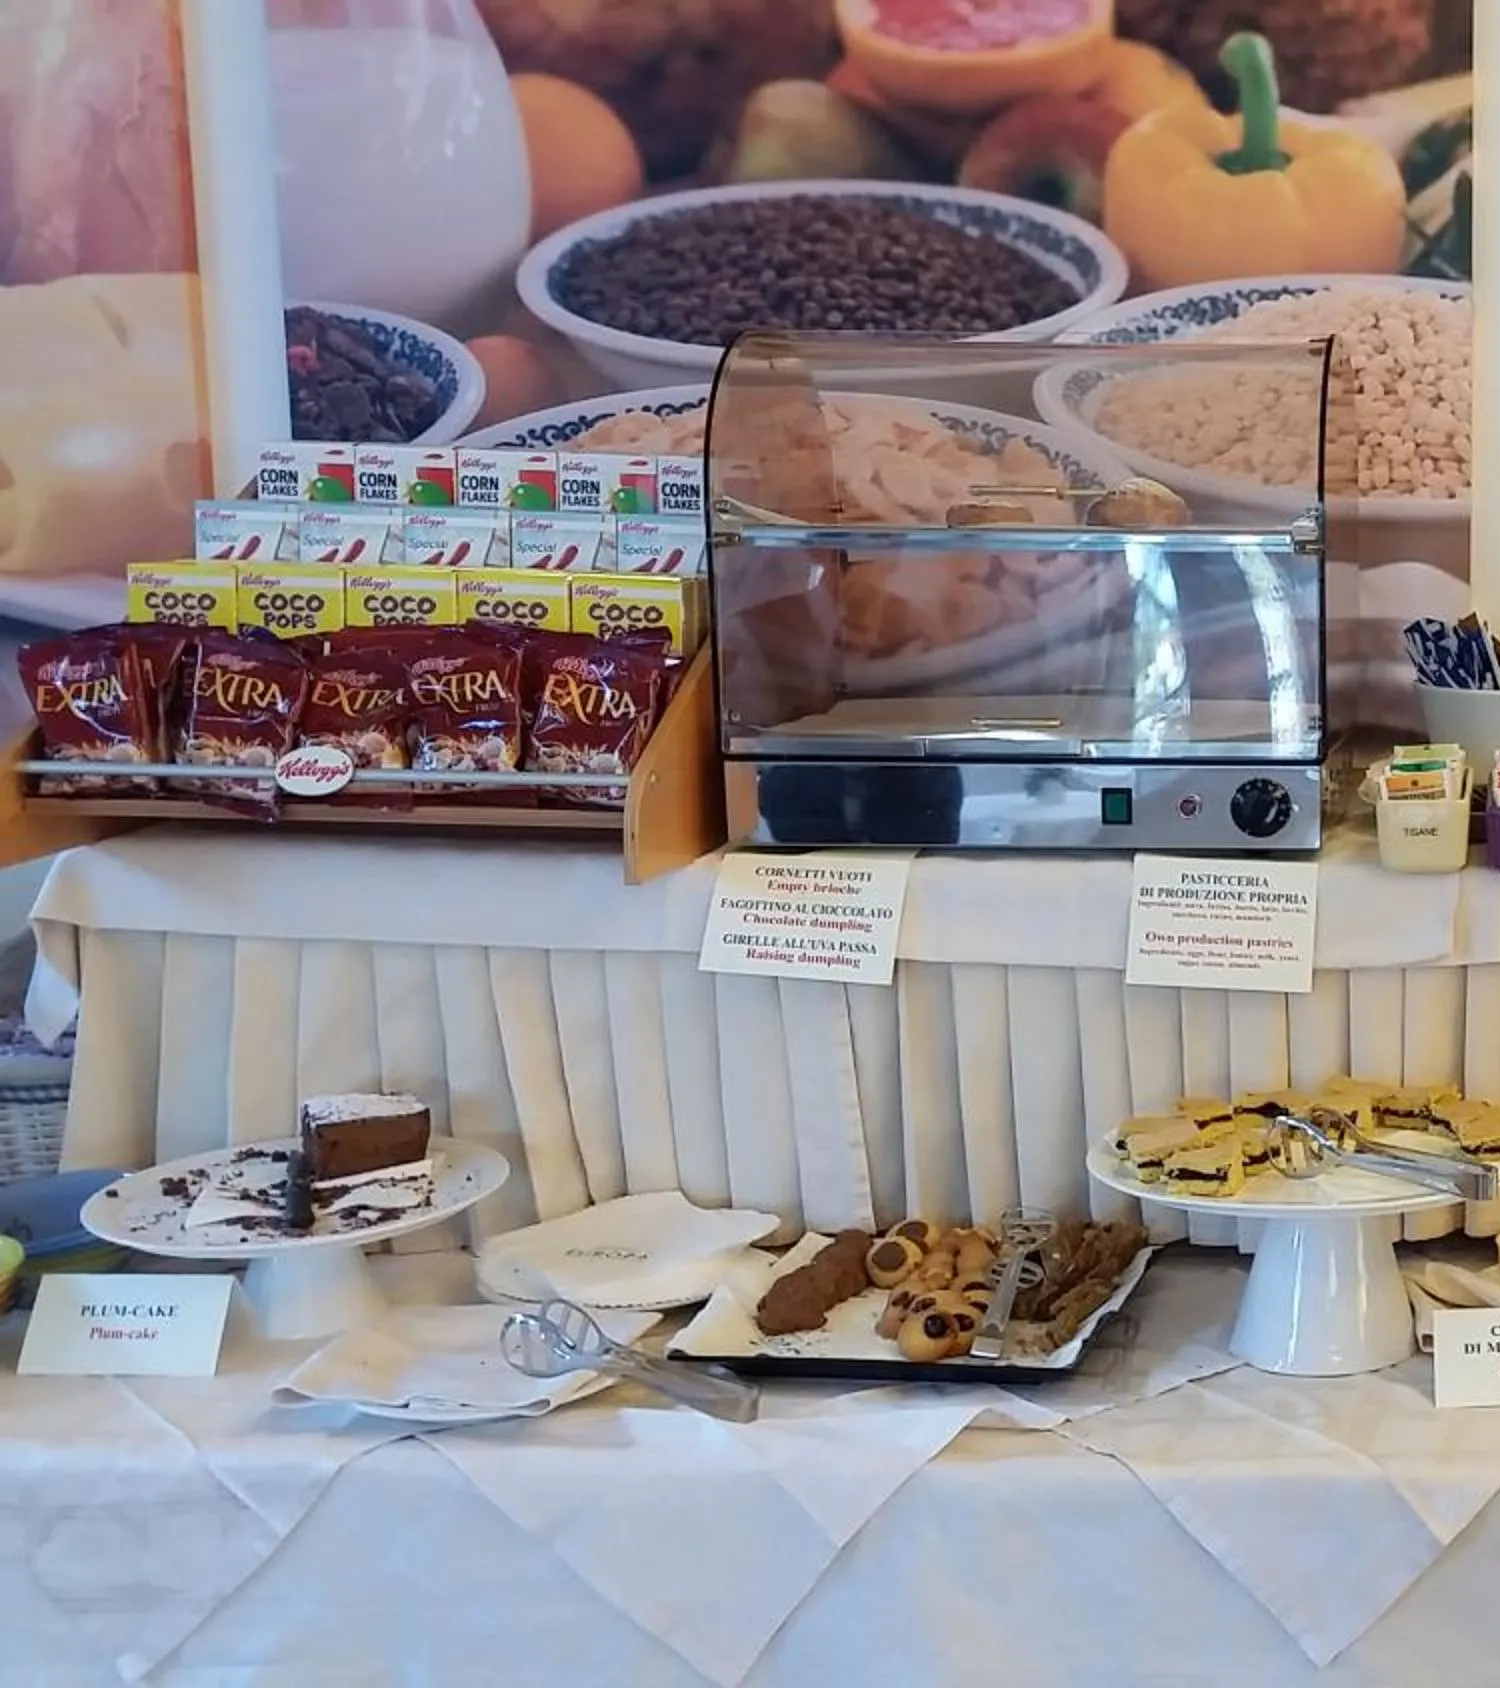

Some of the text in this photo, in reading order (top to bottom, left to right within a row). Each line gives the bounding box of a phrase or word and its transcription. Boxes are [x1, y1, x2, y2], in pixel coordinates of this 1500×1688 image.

[260, 468, 298, 484] CORN
[359, 472, 397, 488] CORN
[461, 475, 498, 490] CORN
[261, 484, 298, 496] FLAKES
[360, 488, 397, 500] FLAKES
[562, 479, 600, 494] CORN
[661, 482, 700, 498] CORN
[461, 491, 498, 502] FLAKES
[562, 495, 600, 507] FLAKES
[662, 498, 701, 510] FLAKES
[145, 591, 217, 611] COCO
[254, 593, 325, 613] COCO
[364, 595, 437, 614] COCO
[475, 600, 549, 619] COCO
[264, 613, 317, 629] POPS
[588, 603, 664, 624] COCO
[36, 673, 129, 713] EXTRA
[197, 667, 283, 714] EXTRA
[311, 681, 405, 717] EXTRA
[411, 670, 508, 713] EXTRA
[543, 673, 638, 725] EXTRA
[278, 757, 350, 783] Kellogg's
[755, 866, 873, 882] CORNETTI VUOTI
[1181, 873, 1269, 888] PASTICCERIA
[767, 879, 862, 896] Empty brioche
[1140, 887, 1308, 905] DI PRODUZIONE PROPRIA
[720, 898, 894, 919] FAGOTTINO AL CIOCCOLATO
[743, 912, 873, 933] Chocolate dumpling
[723, 933, 878, 955] GIRELLE ALL'UVA PASSA
[1145, 931, 1294, 949] Own production pastries
[746, 948, 861, 968] Raising dumpling
[80, 1304, 181, 1318] PLUM-CAKE
[89, 1327, 159, 1340] Plum-cake
[1464, 1343, 1482, 1355] DI
